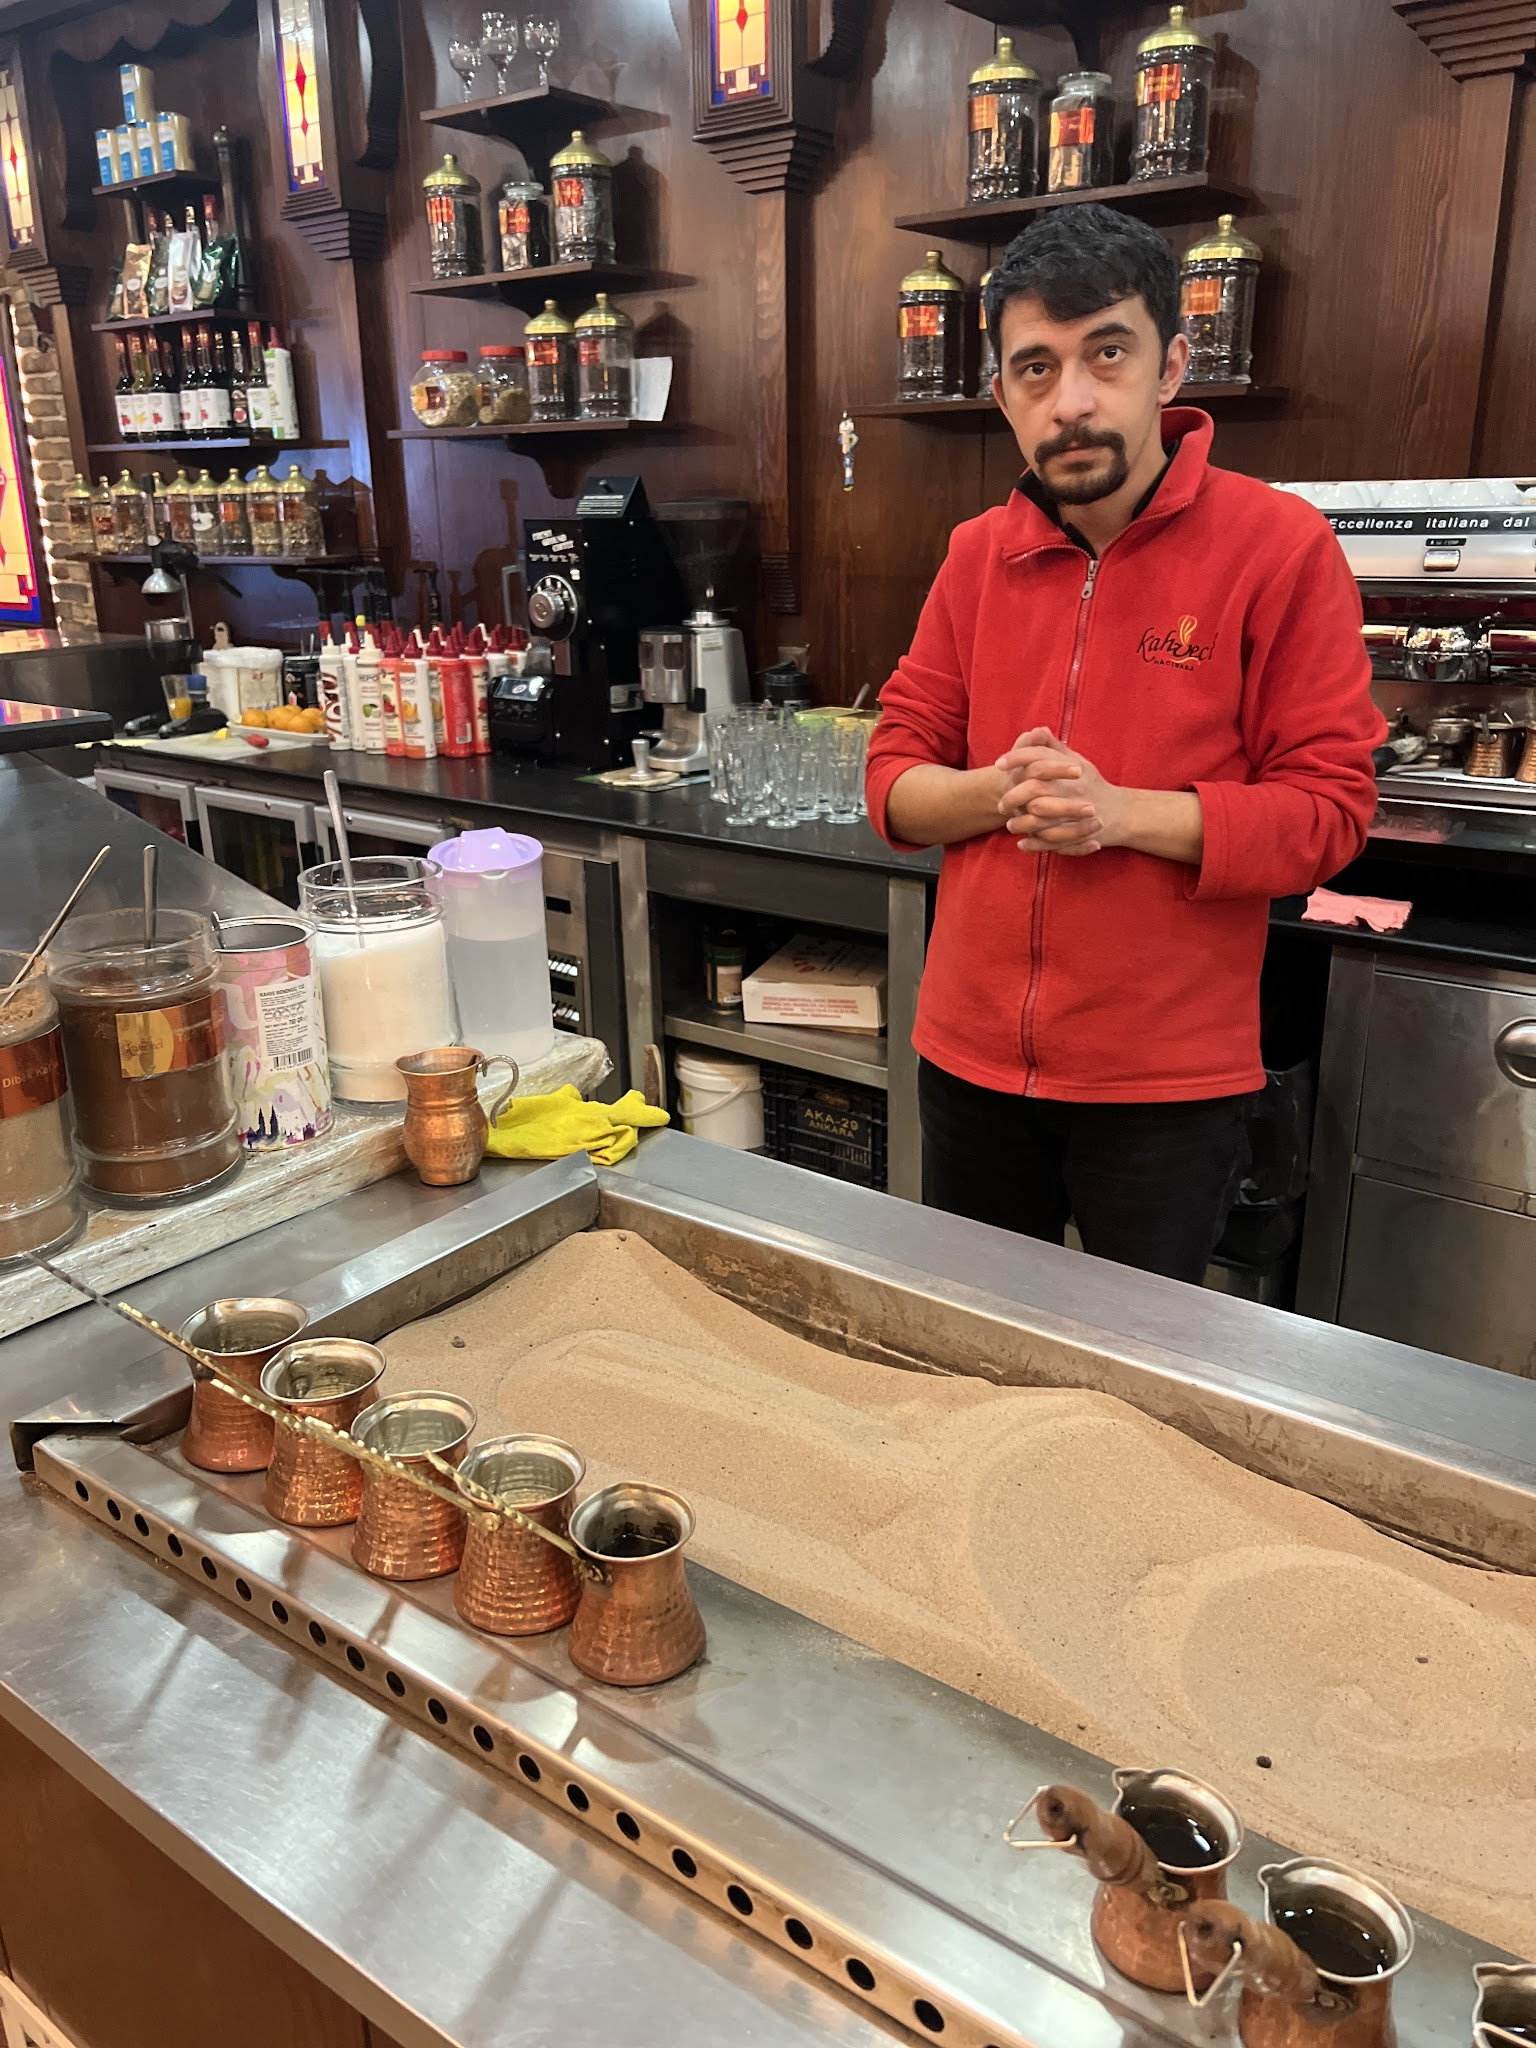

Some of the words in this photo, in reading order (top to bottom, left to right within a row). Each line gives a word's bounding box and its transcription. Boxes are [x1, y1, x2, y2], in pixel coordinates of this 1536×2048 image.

[1329, 517, 1413, 530] Eccellenza
[1425, 516, 1489, 529] italiana
[1502, 516, 1530, 528] dal
[809, 1120, 854, 1139] ANKARA
